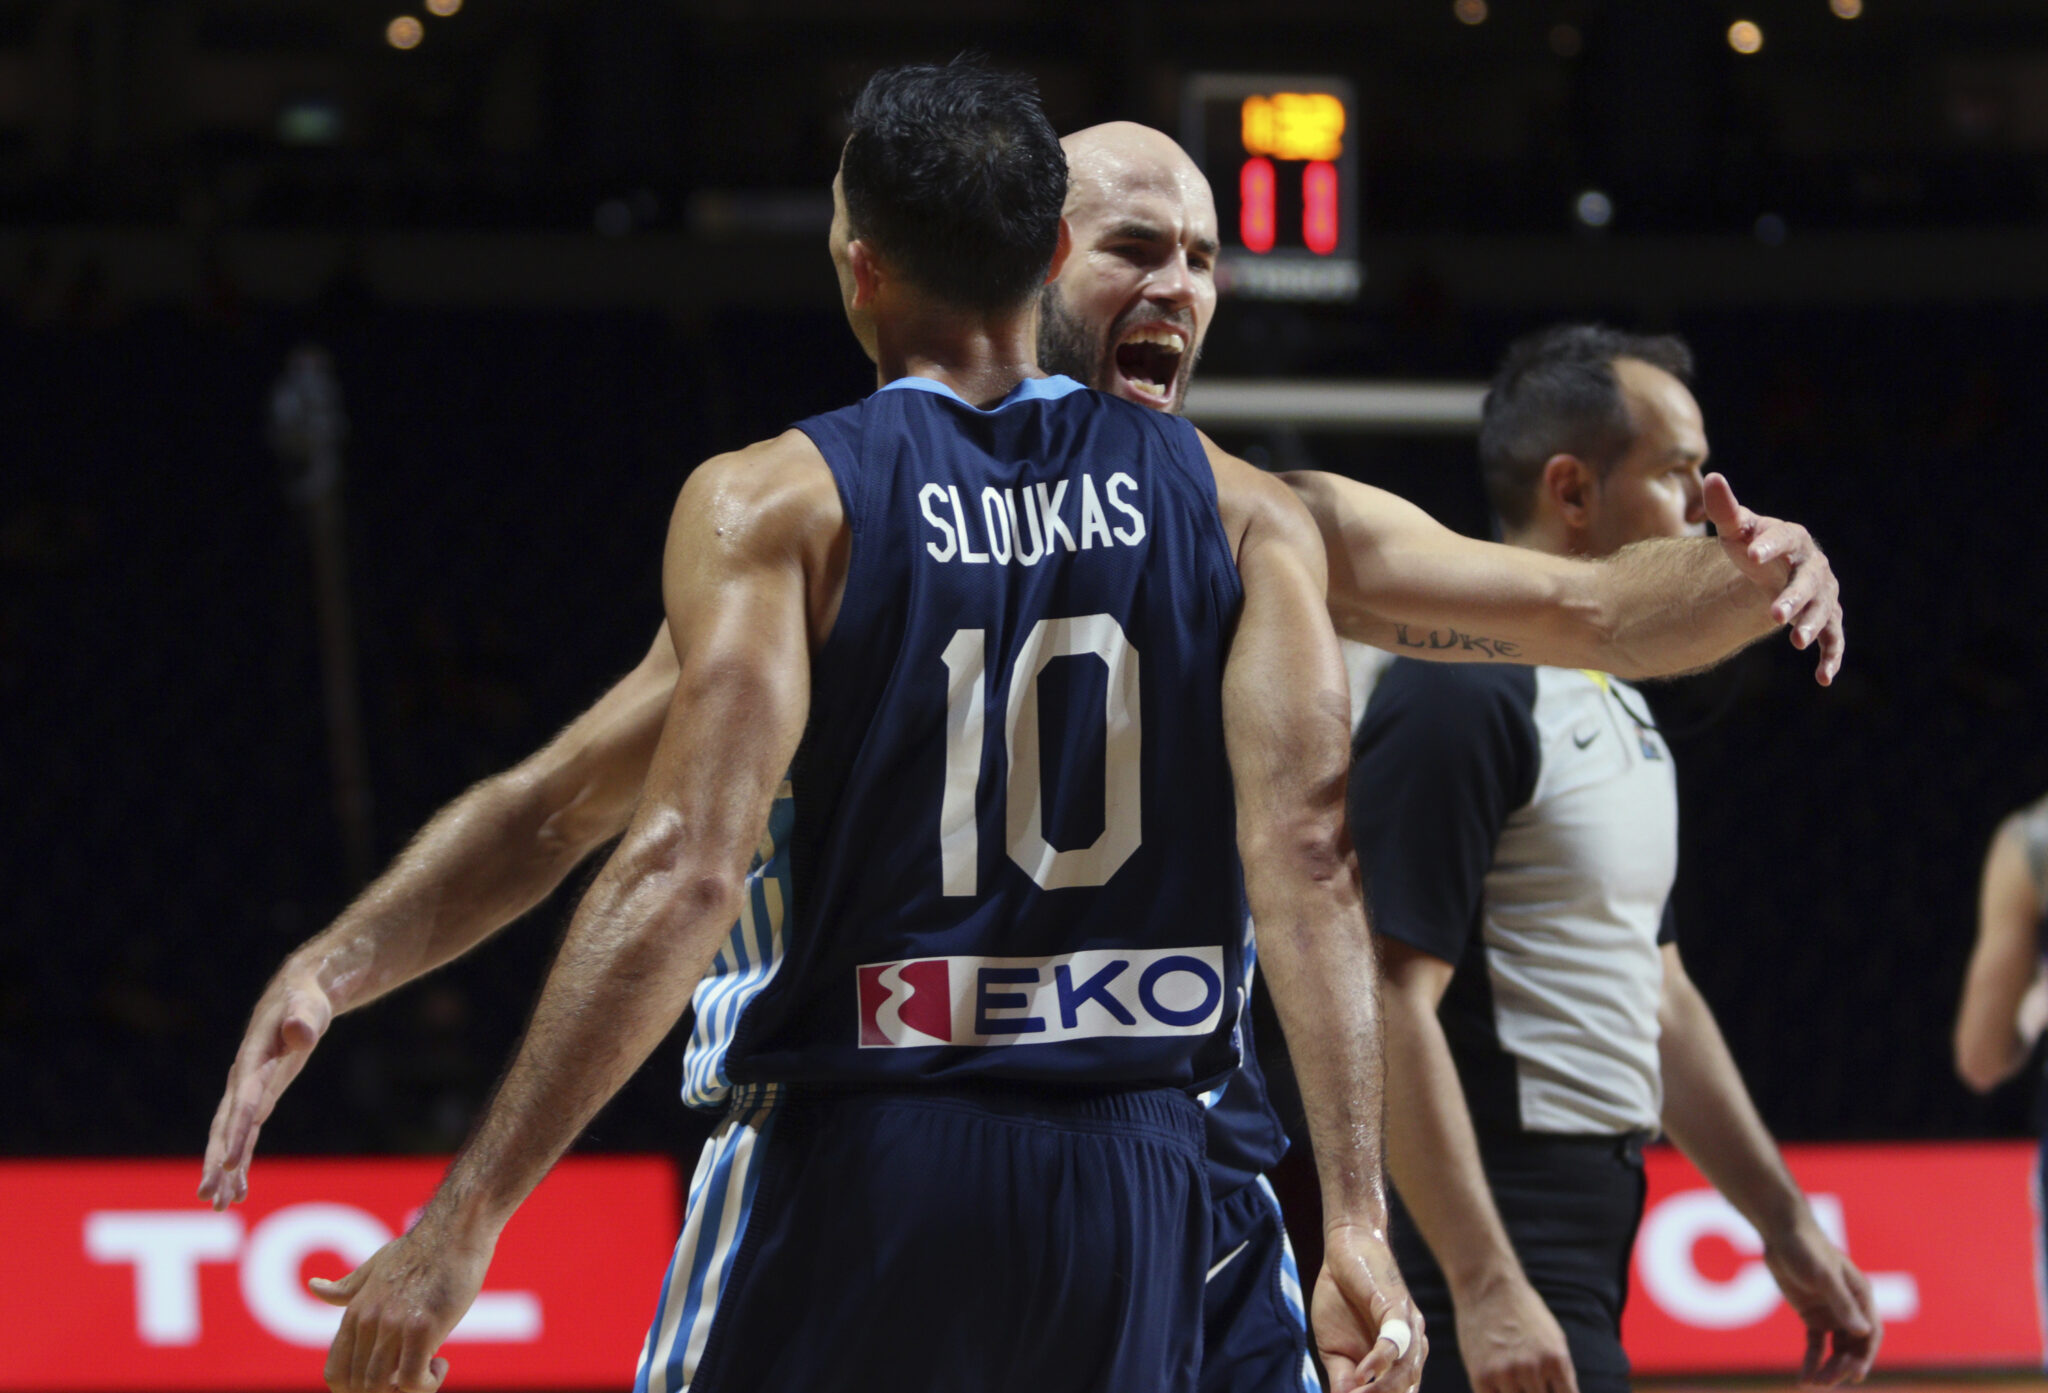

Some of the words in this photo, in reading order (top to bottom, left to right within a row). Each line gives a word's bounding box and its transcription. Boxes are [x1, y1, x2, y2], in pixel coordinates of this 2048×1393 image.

[919, 473, 1146, 566] SLOUKAS
[1394, 624, 1522, 658] LUKE
[941, 614, 1142, 897] 10
[980, 954, 1222, 1034] EKO
